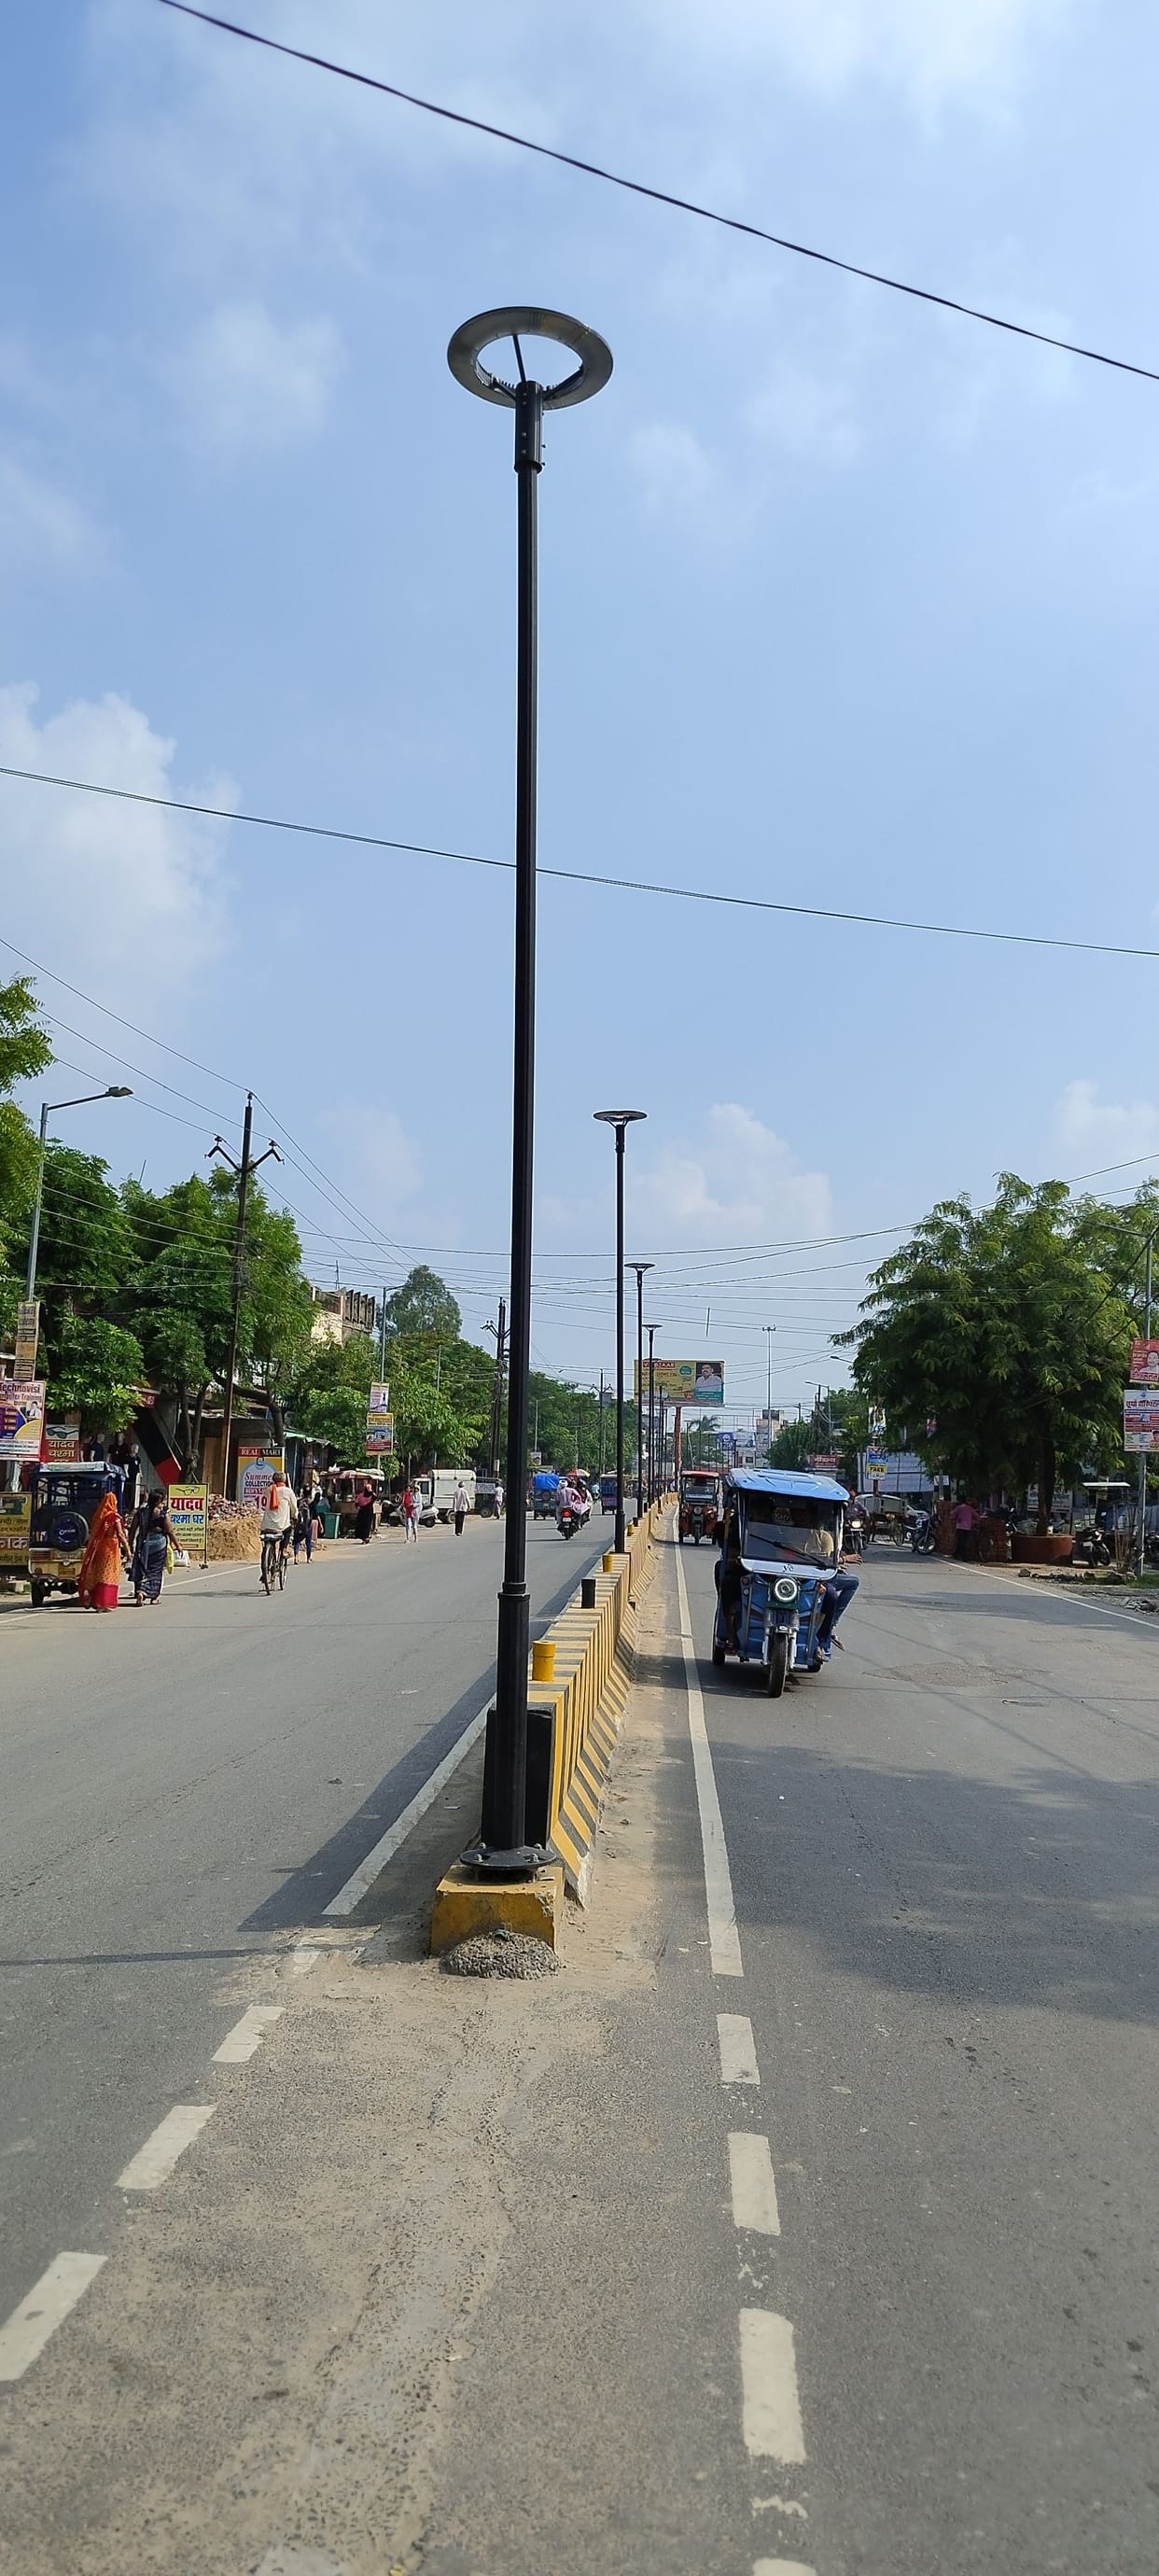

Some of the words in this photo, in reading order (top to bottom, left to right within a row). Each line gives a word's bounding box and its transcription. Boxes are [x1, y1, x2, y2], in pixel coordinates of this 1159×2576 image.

[49, 1440, 75, 1449] यादव
[49, 1449, 75, 1458] चश्मा
[244, 1472, 272, 1481] Summe
[170, 1497, 204, 1511] यादव
[170, 1514, 191, 1524] चश्मा
[192, 1514, 204, 1524] घर
